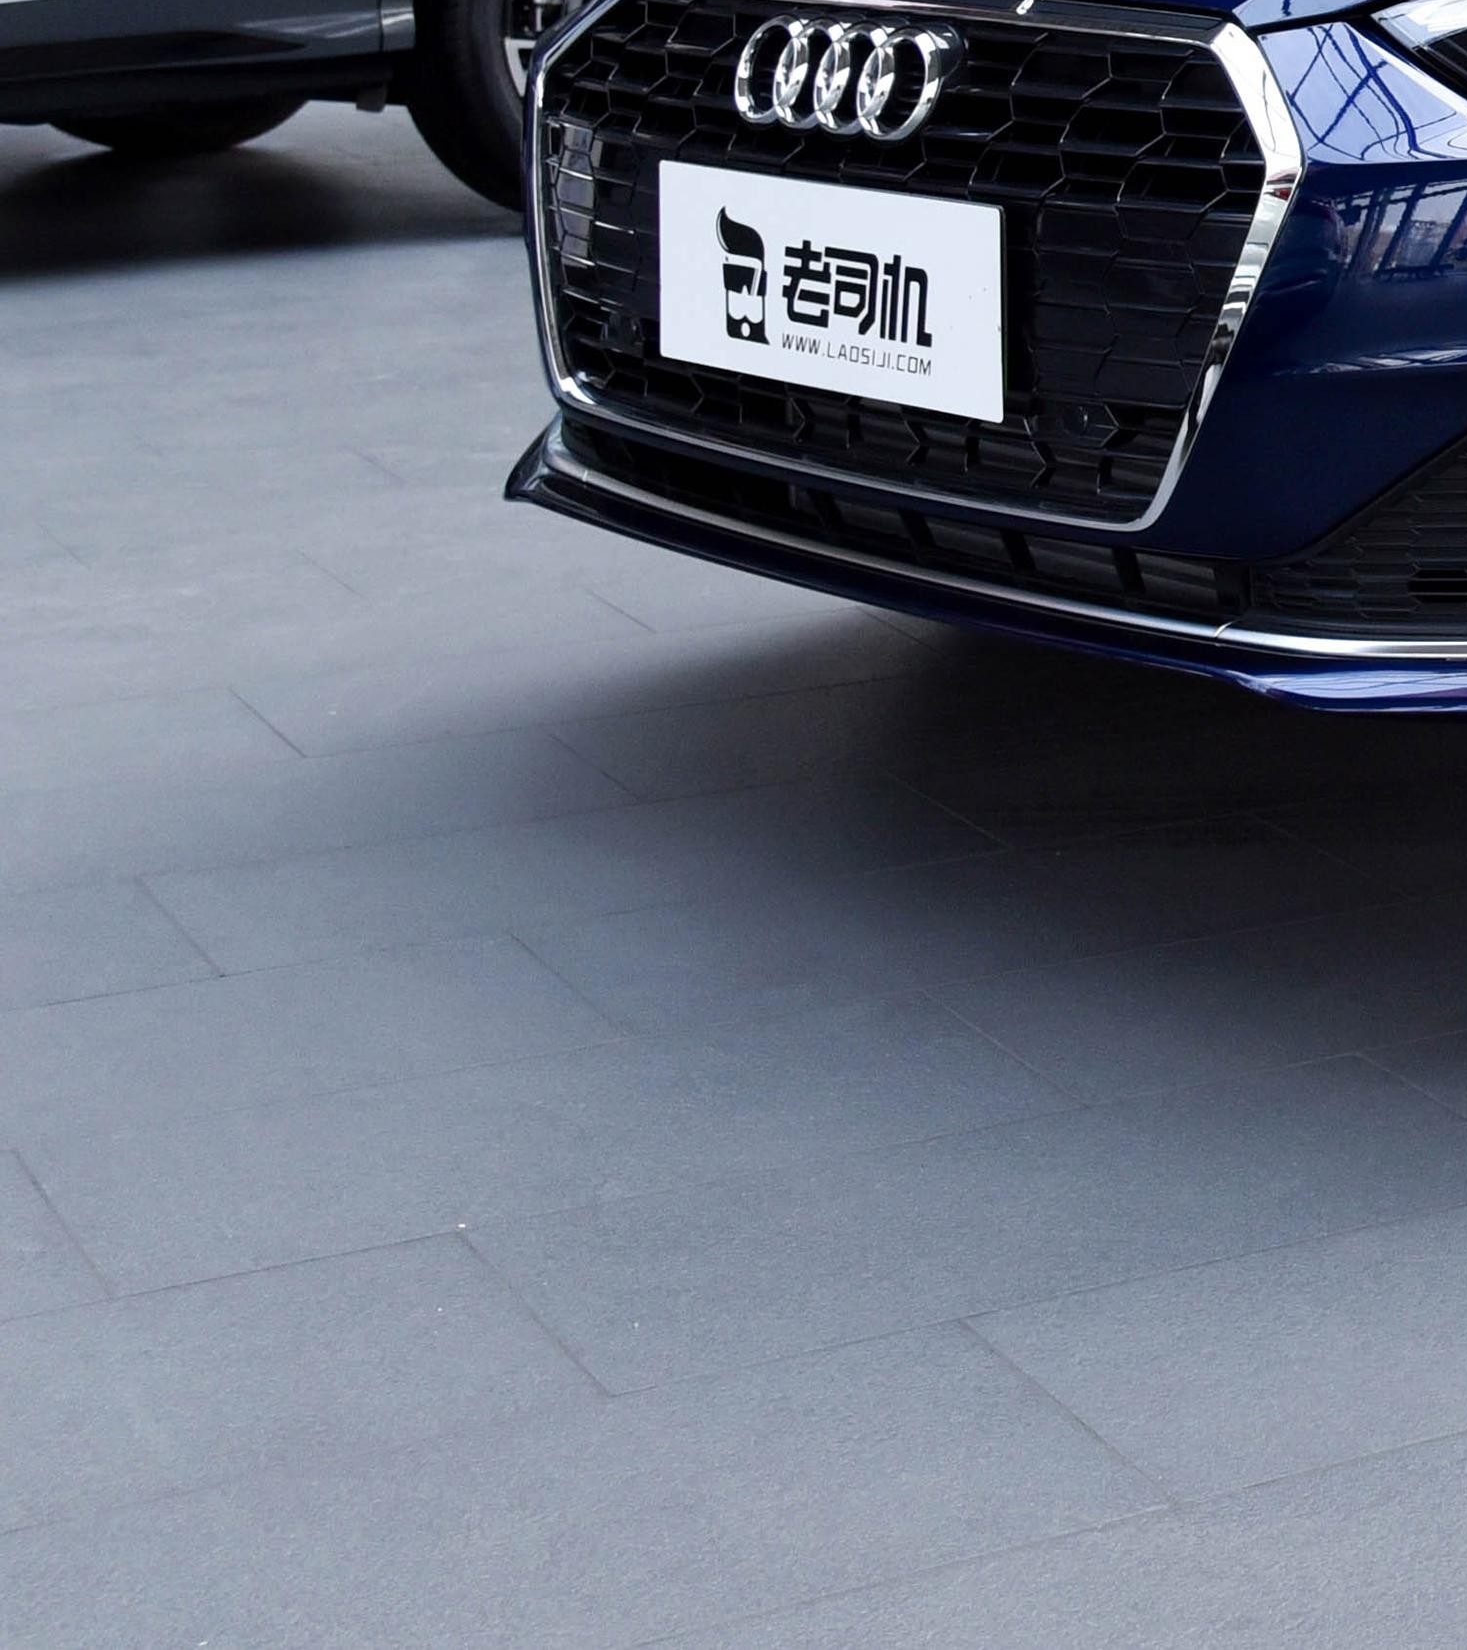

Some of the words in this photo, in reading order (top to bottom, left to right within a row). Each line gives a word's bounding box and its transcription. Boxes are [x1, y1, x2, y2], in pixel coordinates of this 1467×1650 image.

[781, 239, 933, 348] 老司机
[781, 332, 933, 376] WWW.LAOSIJI.COM
